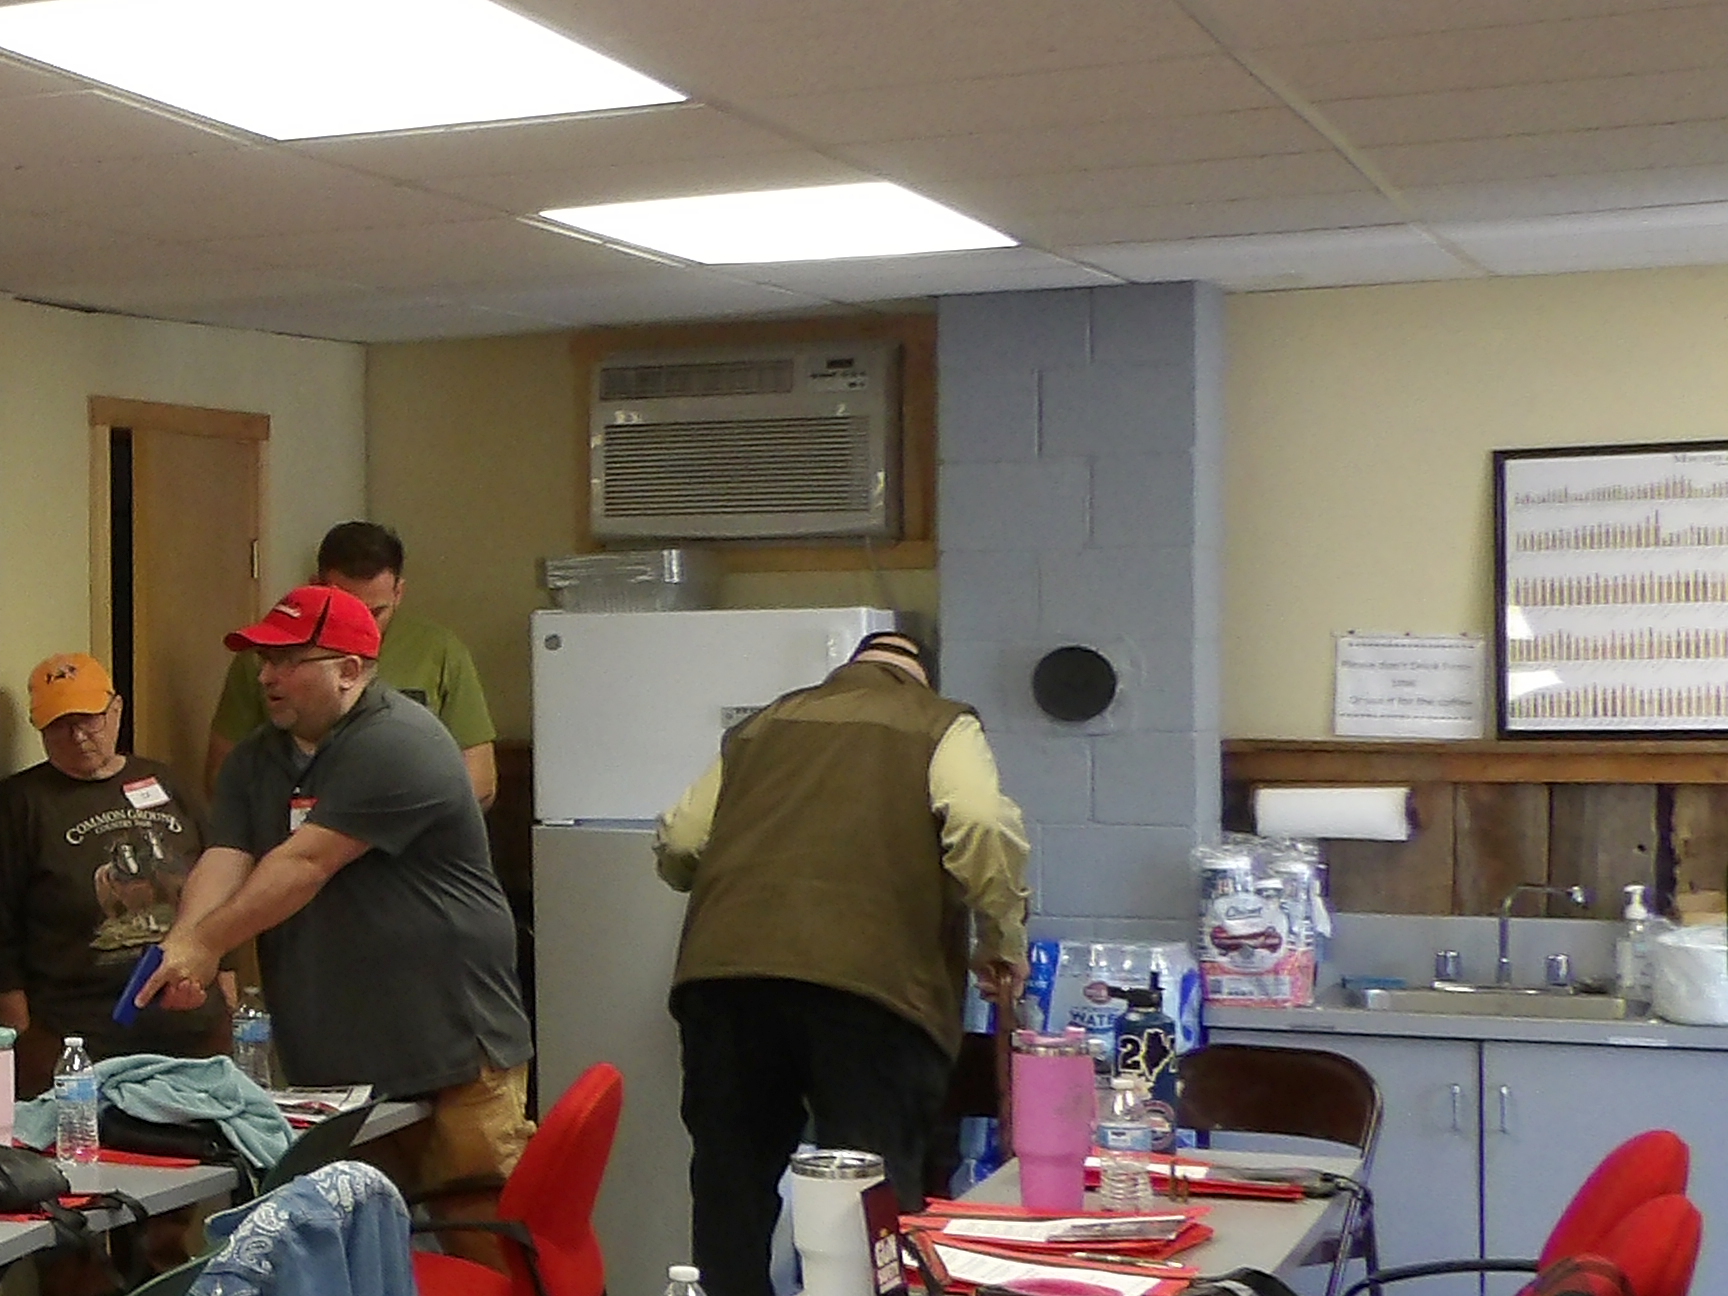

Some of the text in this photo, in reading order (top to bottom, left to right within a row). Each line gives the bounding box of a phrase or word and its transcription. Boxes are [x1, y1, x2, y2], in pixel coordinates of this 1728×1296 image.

[66, 809, 183, 844] COMMON GROUND
[1070, 1010, 1119, 1027] WATE
